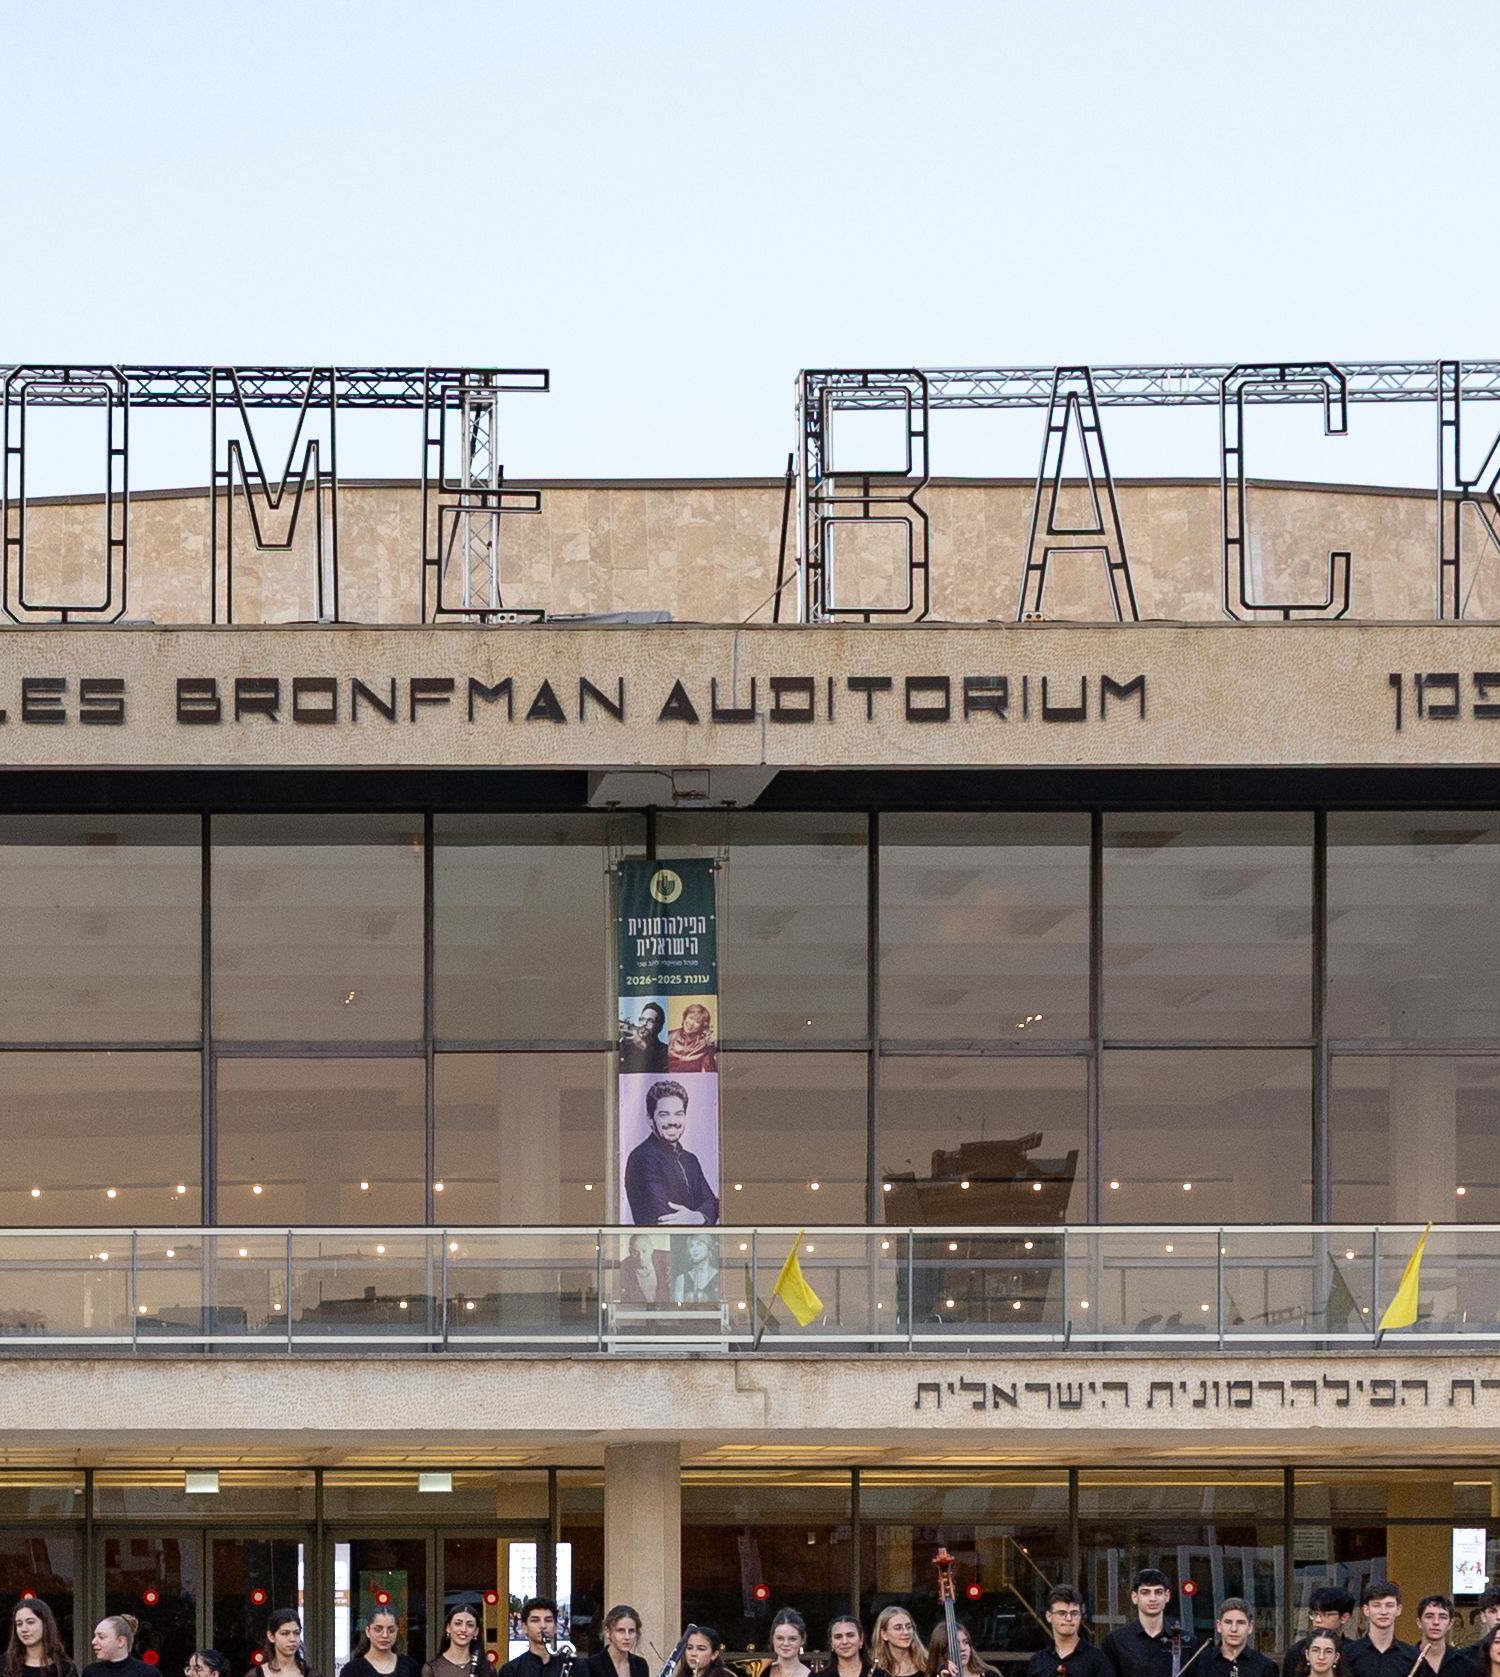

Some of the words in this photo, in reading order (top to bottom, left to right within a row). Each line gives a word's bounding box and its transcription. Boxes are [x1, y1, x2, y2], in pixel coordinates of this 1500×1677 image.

[176, 677, 624, 726] BRONFMAN
[658, 674, 1146, 726] AUDITORIUM
[628, 916, 707, 936] הפילהרמונית
[636, 937, 699, 957] הישראלית
[684, 974, 710, 984] עונת
[914, 1376, 1129, 1410] הישראלית
[1147, 1373, 1428, 1409] הפילהרמונית
